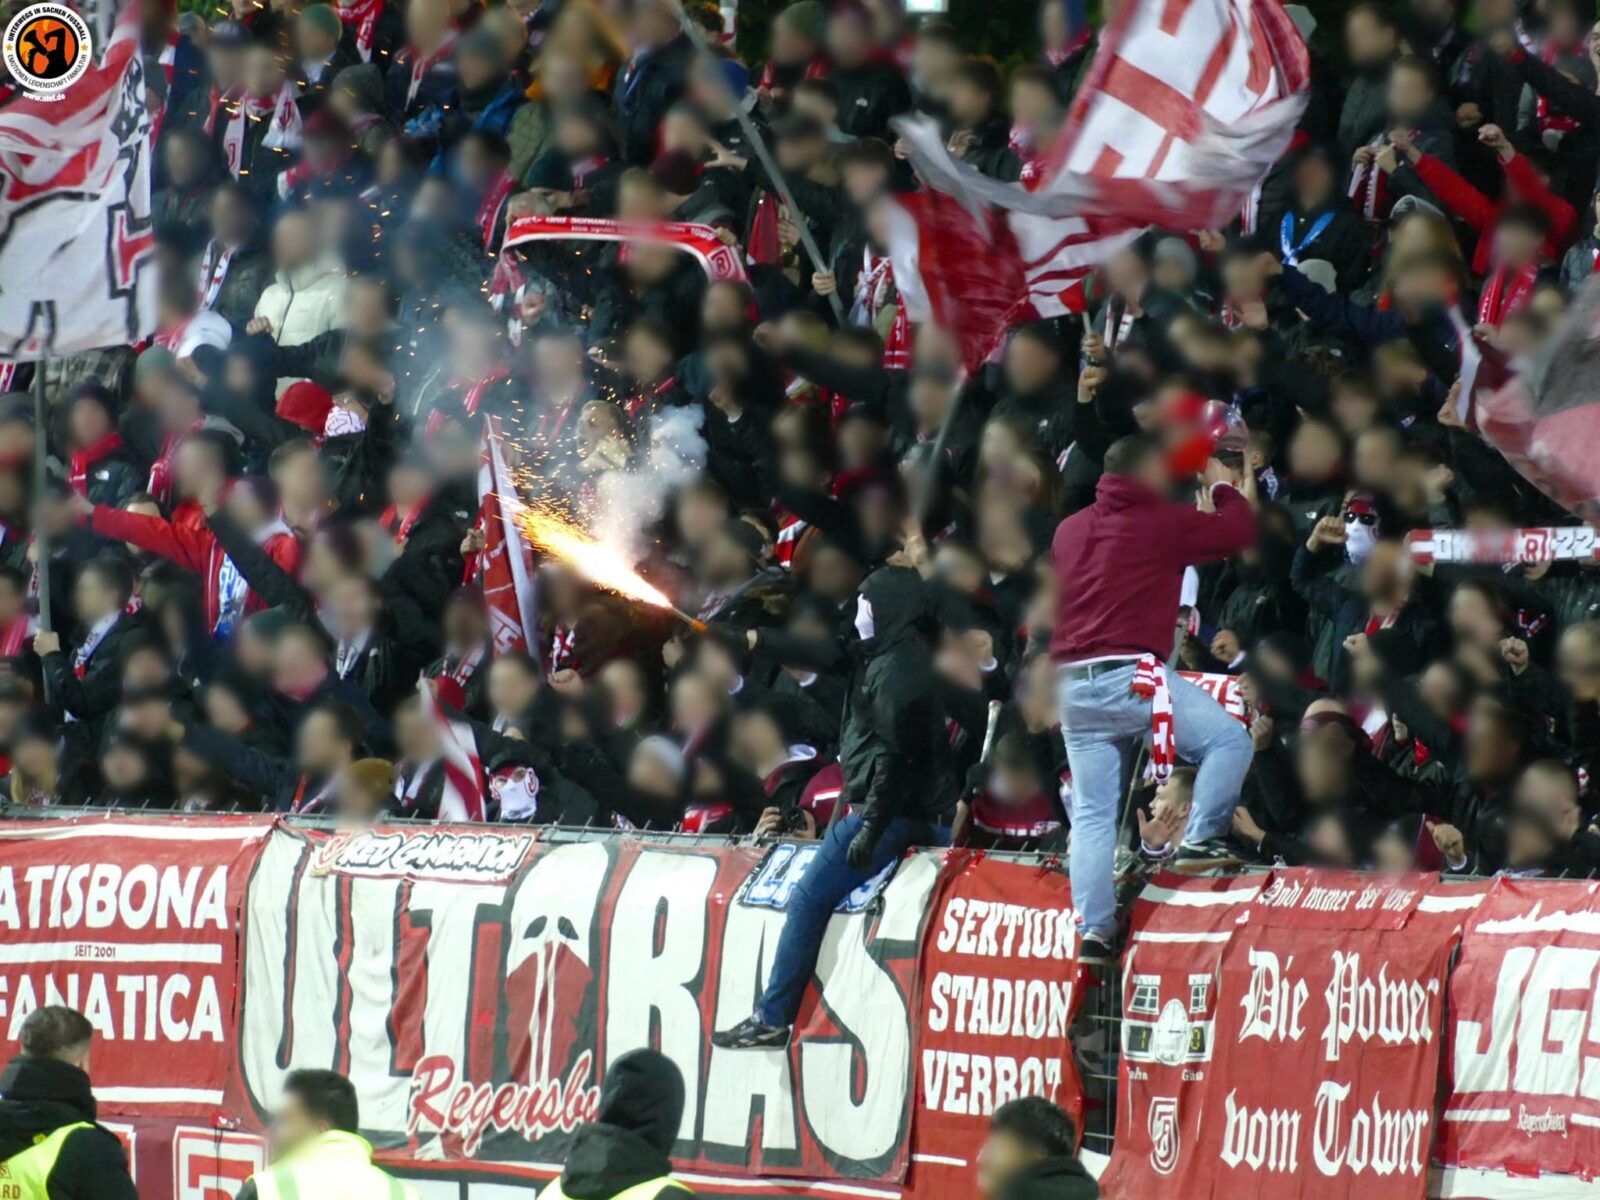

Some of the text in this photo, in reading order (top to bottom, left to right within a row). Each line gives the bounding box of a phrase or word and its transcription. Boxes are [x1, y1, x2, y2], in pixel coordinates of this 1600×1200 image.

[0, 863, 229, 930] ATISBONA
[74, 944, 117, 958] SEIT 2001
[243, 828, 937, 1162] ULTRAS
[928, 972, 1072, 1040] STADION
[1239, 945, 1440, 1062] Die Power
[1219, 1080, 1429, 1178] vom Tower
[0, 1184, 21, 1199] RD
